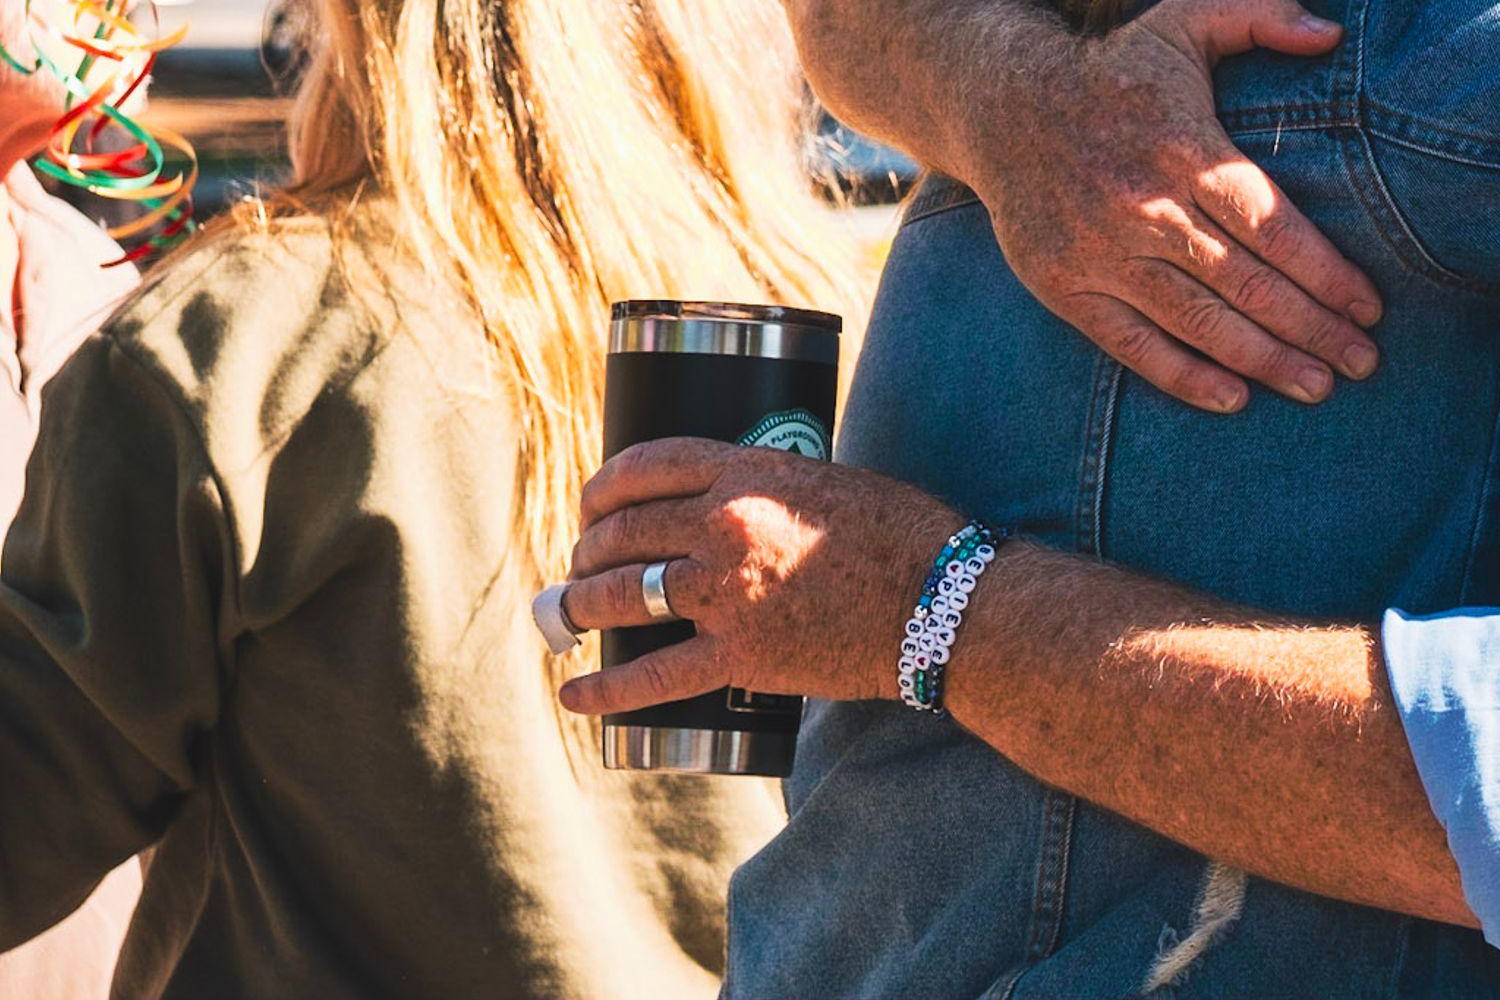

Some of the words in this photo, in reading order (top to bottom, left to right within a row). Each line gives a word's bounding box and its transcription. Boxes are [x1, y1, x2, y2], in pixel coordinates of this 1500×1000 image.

[770, 430, 819, 450] PLAYGROUND
[920, 579, 954, 649] PLAY
[932, 546, 993, 662] BELIEVE
